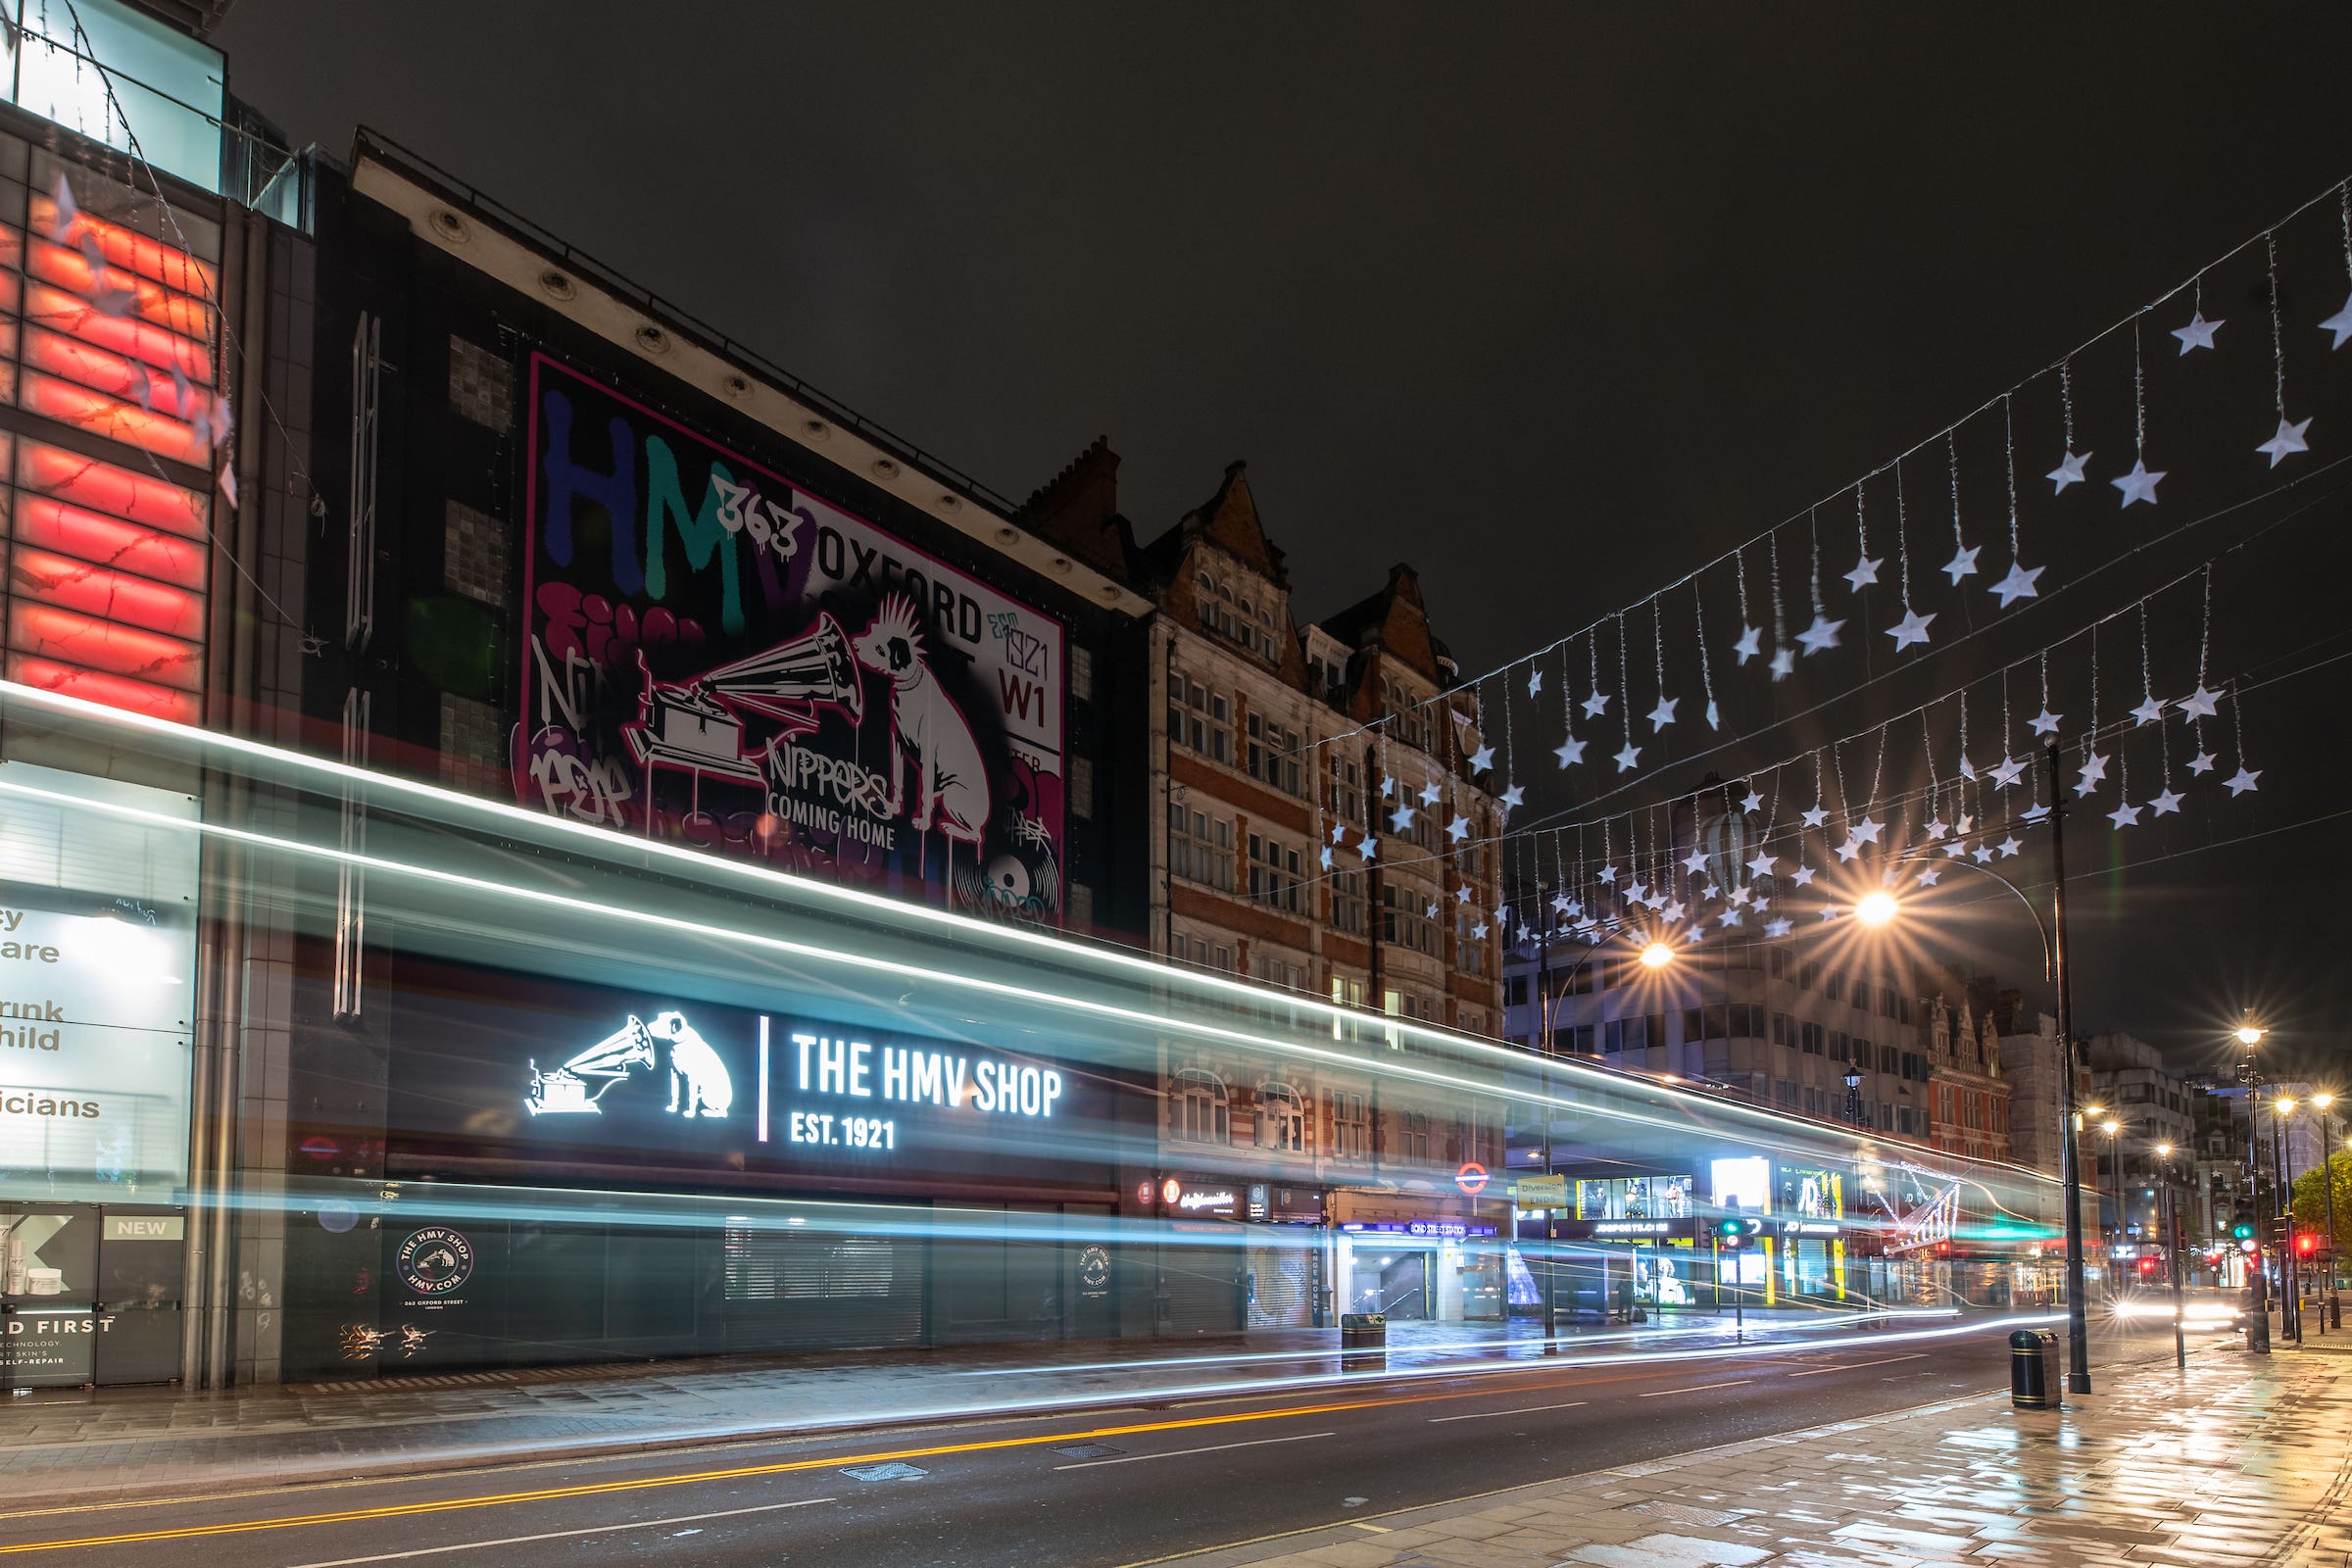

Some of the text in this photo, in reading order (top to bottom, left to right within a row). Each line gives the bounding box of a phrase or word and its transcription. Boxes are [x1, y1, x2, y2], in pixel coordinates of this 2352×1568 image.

[543, 390, 817, 635] HMV
[711, 472, 804, 563] 363
[818, 526, 982, 644] OXFORD
[1003, 624, 1048, 682] 1921
[998, 667, 1044, 727] W1
[768, 792, 840, 835] COMING
[847, 814, 896, 851] HOME
[792, 1033, 1062, 1117] THE HMV SHOP
[791, 1111, 895, 1151] EST. 1921
[1521, 1183, 1562, 1192] Diversion
[1530, 1196, 1556, 1204] ENDS
[1797, 1178, 1818, 1213] JD
[118, 1221, 167, 1235] NEW
[1411, 1224, 1466, 1234] BOND STREET STATION
[1784, 1221, 1799, 1232] JD
[401, 1231, 469, 1260] THE HMV SHOP
[408, 1274, 462, 1291] HMV.COM
[37, 1318, 116, 1334] FIRST
